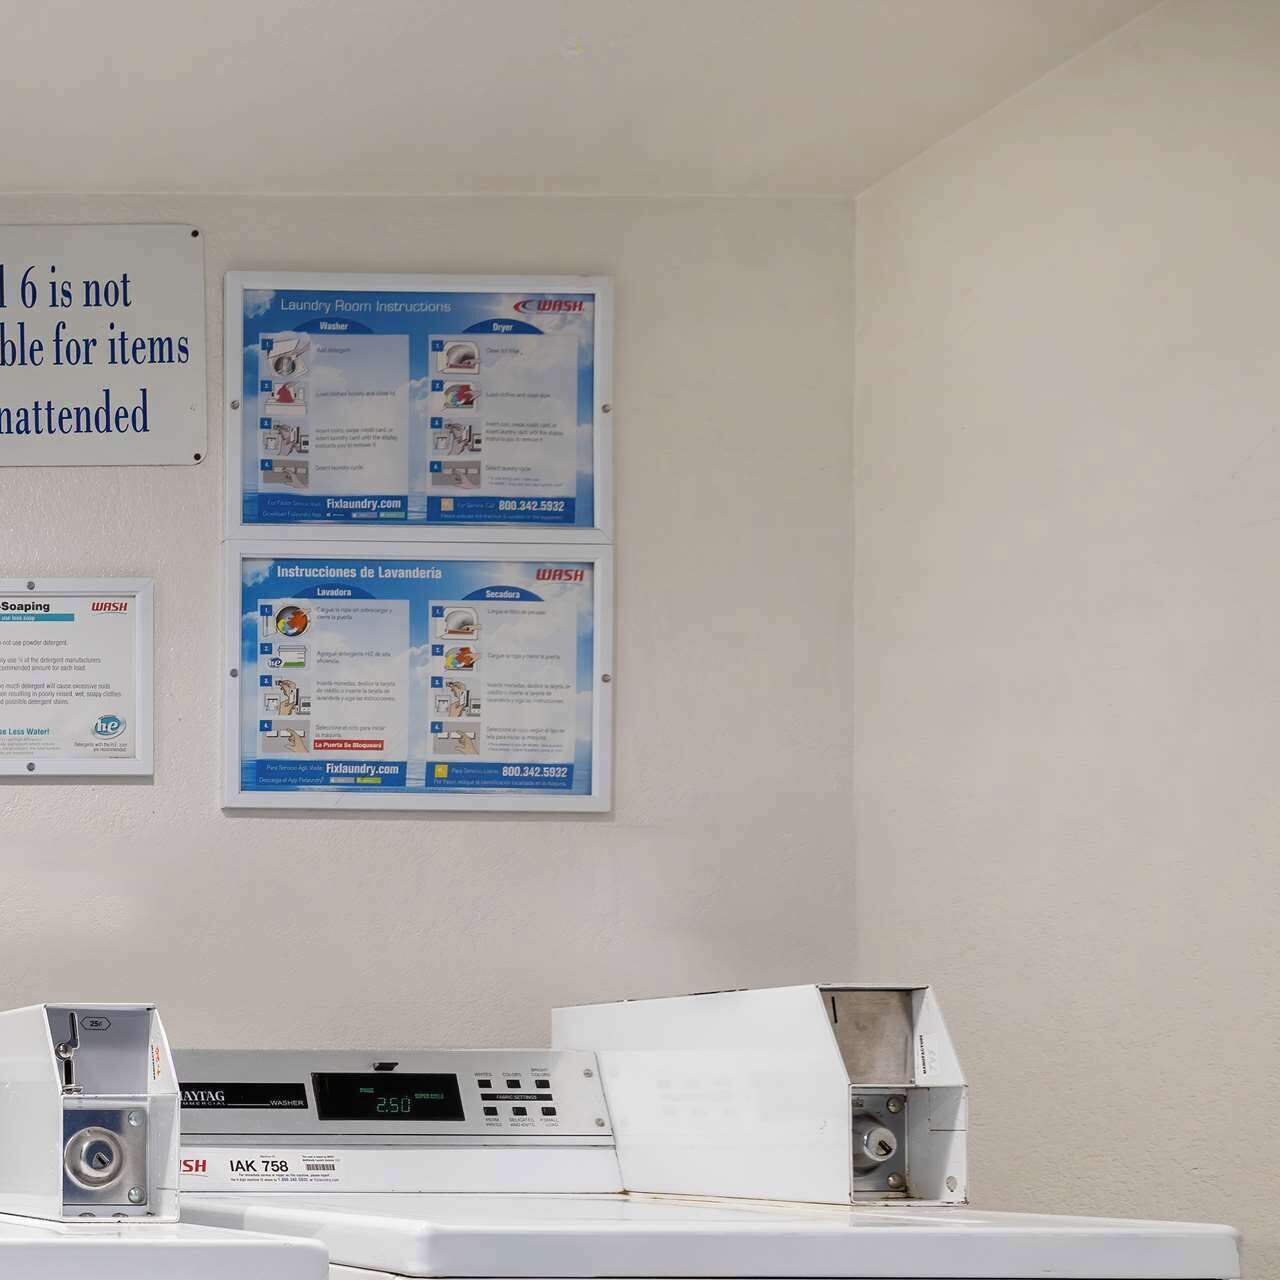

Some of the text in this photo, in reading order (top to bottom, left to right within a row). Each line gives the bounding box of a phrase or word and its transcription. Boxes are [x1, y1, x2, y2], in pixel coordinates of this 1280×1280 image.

[21, 265, 37, 308] 6
[49, 265, 72, 308] is
[83, 273, 132, 307] not
[281, 299, 452, 313] Laundry Room Instructions
[537, 299, 582, 311] WASH
[320, 322, 348, 330] Washer
[493, 323, 513, 332] Dryer
[53, 321, 97, 366] for
[108, 322, 189, 365] items
[327, 498, 401, 511] Fixlaundry.com
[499, 500, 564, 511] 800.342.5932
[277, 566, 356, 578] Instrucciones
[360, 567, 374, 578] de
[536, 569, 584, 581] WASH
[317, 588, 352, 596] Lavadora
[486, 590, 520, 598] Secadora
[92, 602, 127, 612] WASH
[326, 763, 399, 776] Fixlaundry.com
[502, 767, 568, 777] 800.342.5932
[377, 1097, 410, 1112] 2.50
[230, 1160, 288, 1172] IAK 758
